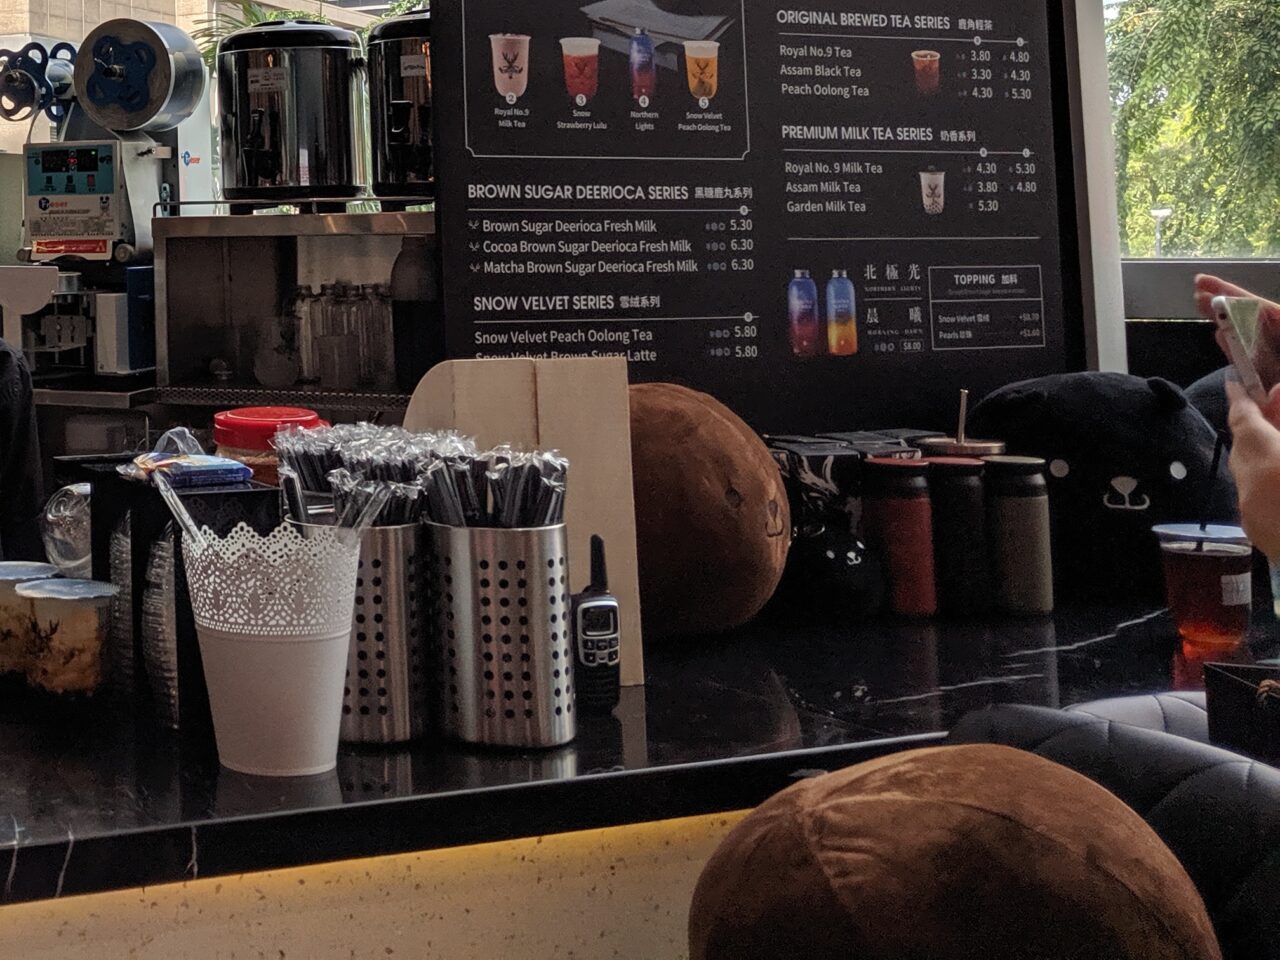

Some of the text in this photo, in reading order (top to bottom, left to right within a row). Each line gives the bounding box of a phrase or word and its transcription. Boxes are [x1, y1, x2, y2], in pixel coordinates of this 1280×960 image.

[777, 10, 837, 25] ORIGINAL
[840, 13, 887, 27] BREWED
[890, 15, 911, 28] TEA
[914, 16, 950, 29] SERIES
[780, 45, 852, 58] Royal No.9 Tea
[971, 50, 990, 61] 3.80
[780, 65, 861, 77] Assam Black Tea
[971, 69, 991, 80] 3.30
[782, 84, 869, 98] Peach Oolong Tea
[972, 87, 992, 98] 4.30
[631, 111, 659, 119] Northern
[635, 122, 654, 131] Lights
[782, 125, 933, 140] PREMIUM MILK TEA SERIES
[785, 162, 882, 175] Royal No. 9 Milk Tea
[468, 185, 688, 200] BROWN SUGAR DEERIOCA SERIES
[786, 182, 861, 193] Assam Milk Tea
[787, 201, 866, 212] Garden Milk Tea
[979, 201, 998, 211] 5.30
[483, 220, 657, 235] Brown Sugar Deerioca Fresh Milk
[730, 220, 752, 231] 5.30
[483, 240, 691, 255] Cocoa Brown Sugar Deerioca Fresh Milk
[731, 240, 753, 251] 6.30
[484, 261, 698, 276] Matcha Brown Sugar Deerioca Fresh Milk
[731, 259, 754, 270] 6.30
[864, 264, 921, 281] 北極光
[954, 274, 995, 285] TOPPING
[474, 296, 614, 311] SNOW VELVET SERIES
[475, 329, 653, 345] Snow Velvet Peach Oolong Tea
[735, 326, 756, 338] 5.80
[627, 350, 657, 361] Latte
[735, 347, 757, 358] 5.80
